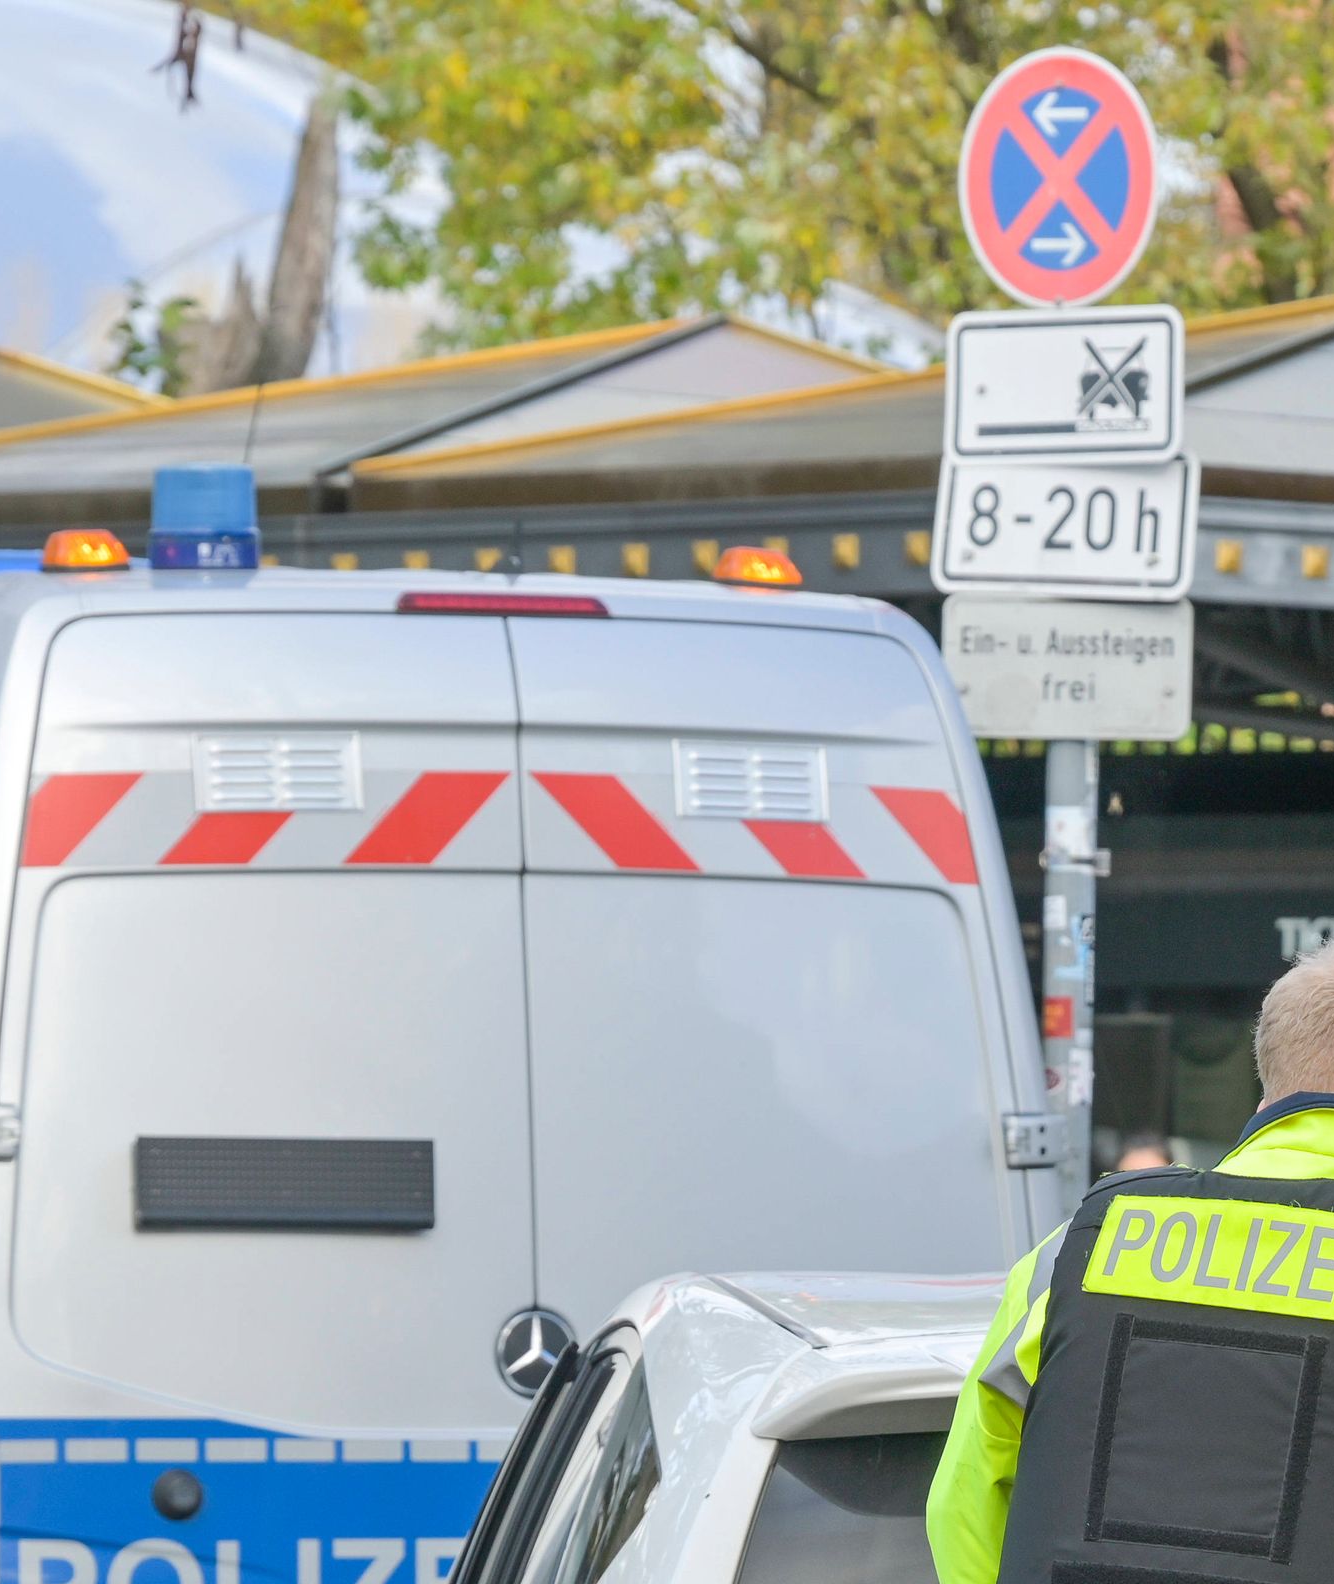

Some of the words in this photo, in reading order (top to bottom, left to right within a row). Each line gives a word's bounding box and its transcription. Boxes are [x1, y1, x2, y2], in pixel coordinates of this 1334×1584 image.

[960, 625, 1007, 655] Ein-
[1018, 633, 1037, 656] u.
[1045, 627, 1175, 664] Aussteigen
[1042, 672, 1097, 702] frei
